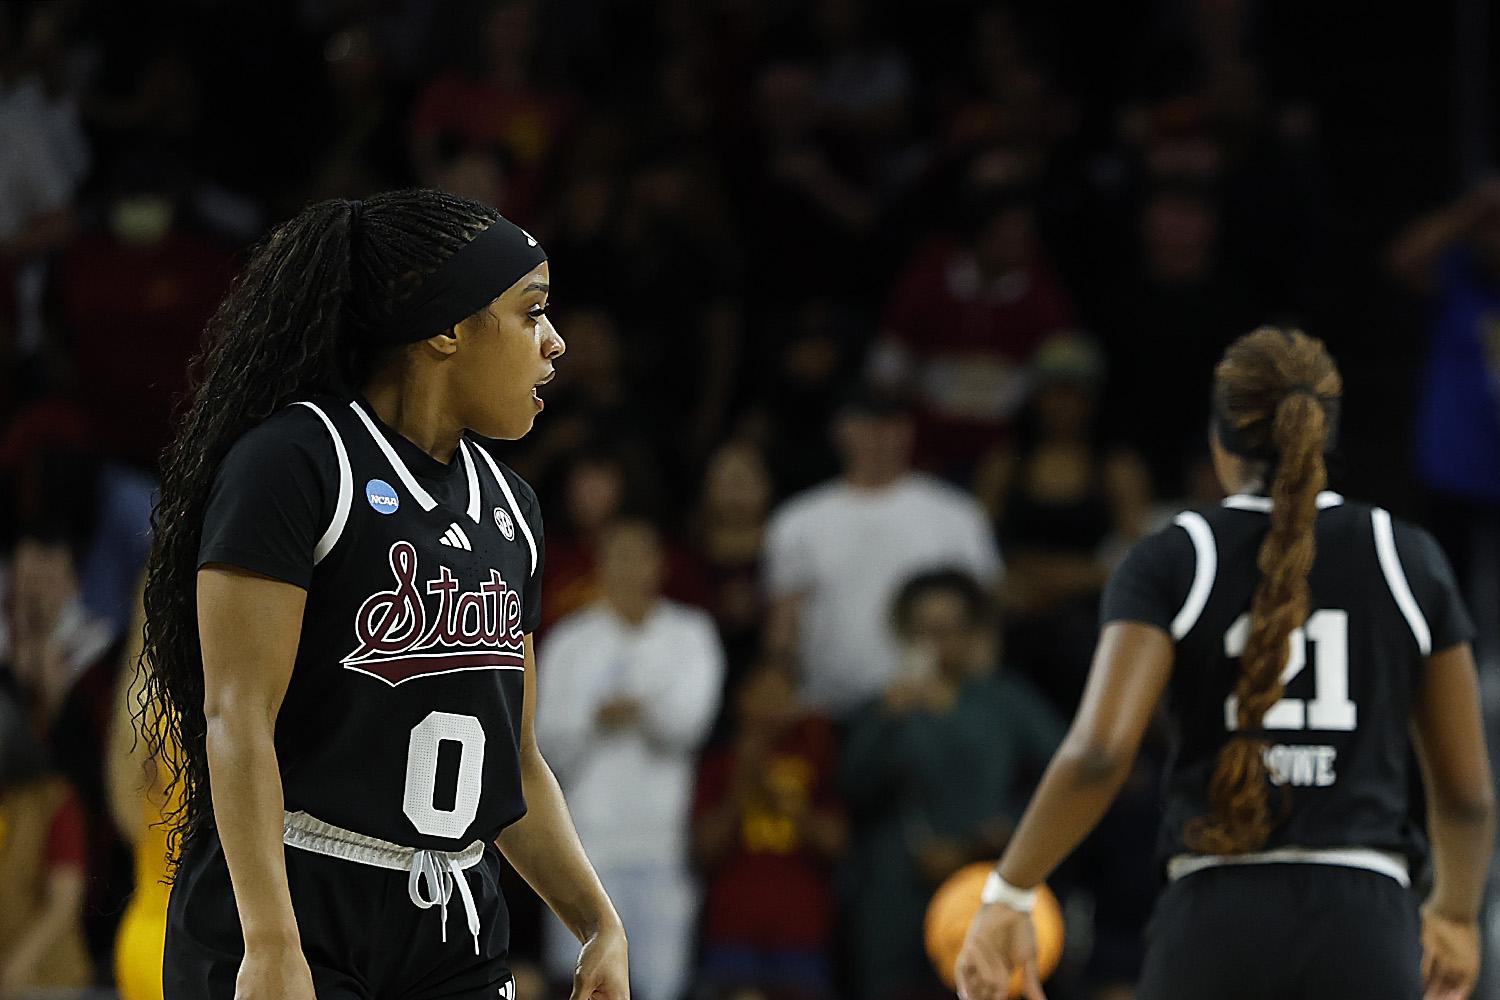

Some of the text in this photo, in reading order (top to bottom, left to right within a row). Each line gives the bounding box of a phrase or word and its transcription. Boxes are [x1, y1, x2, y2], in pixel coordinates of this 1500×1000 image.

[370, 494, 399, 507] NCAA
[340, 541, 524, 664] State
[1224, 609, 1357, 731] 21
[403, 711, 486, 839] 0
